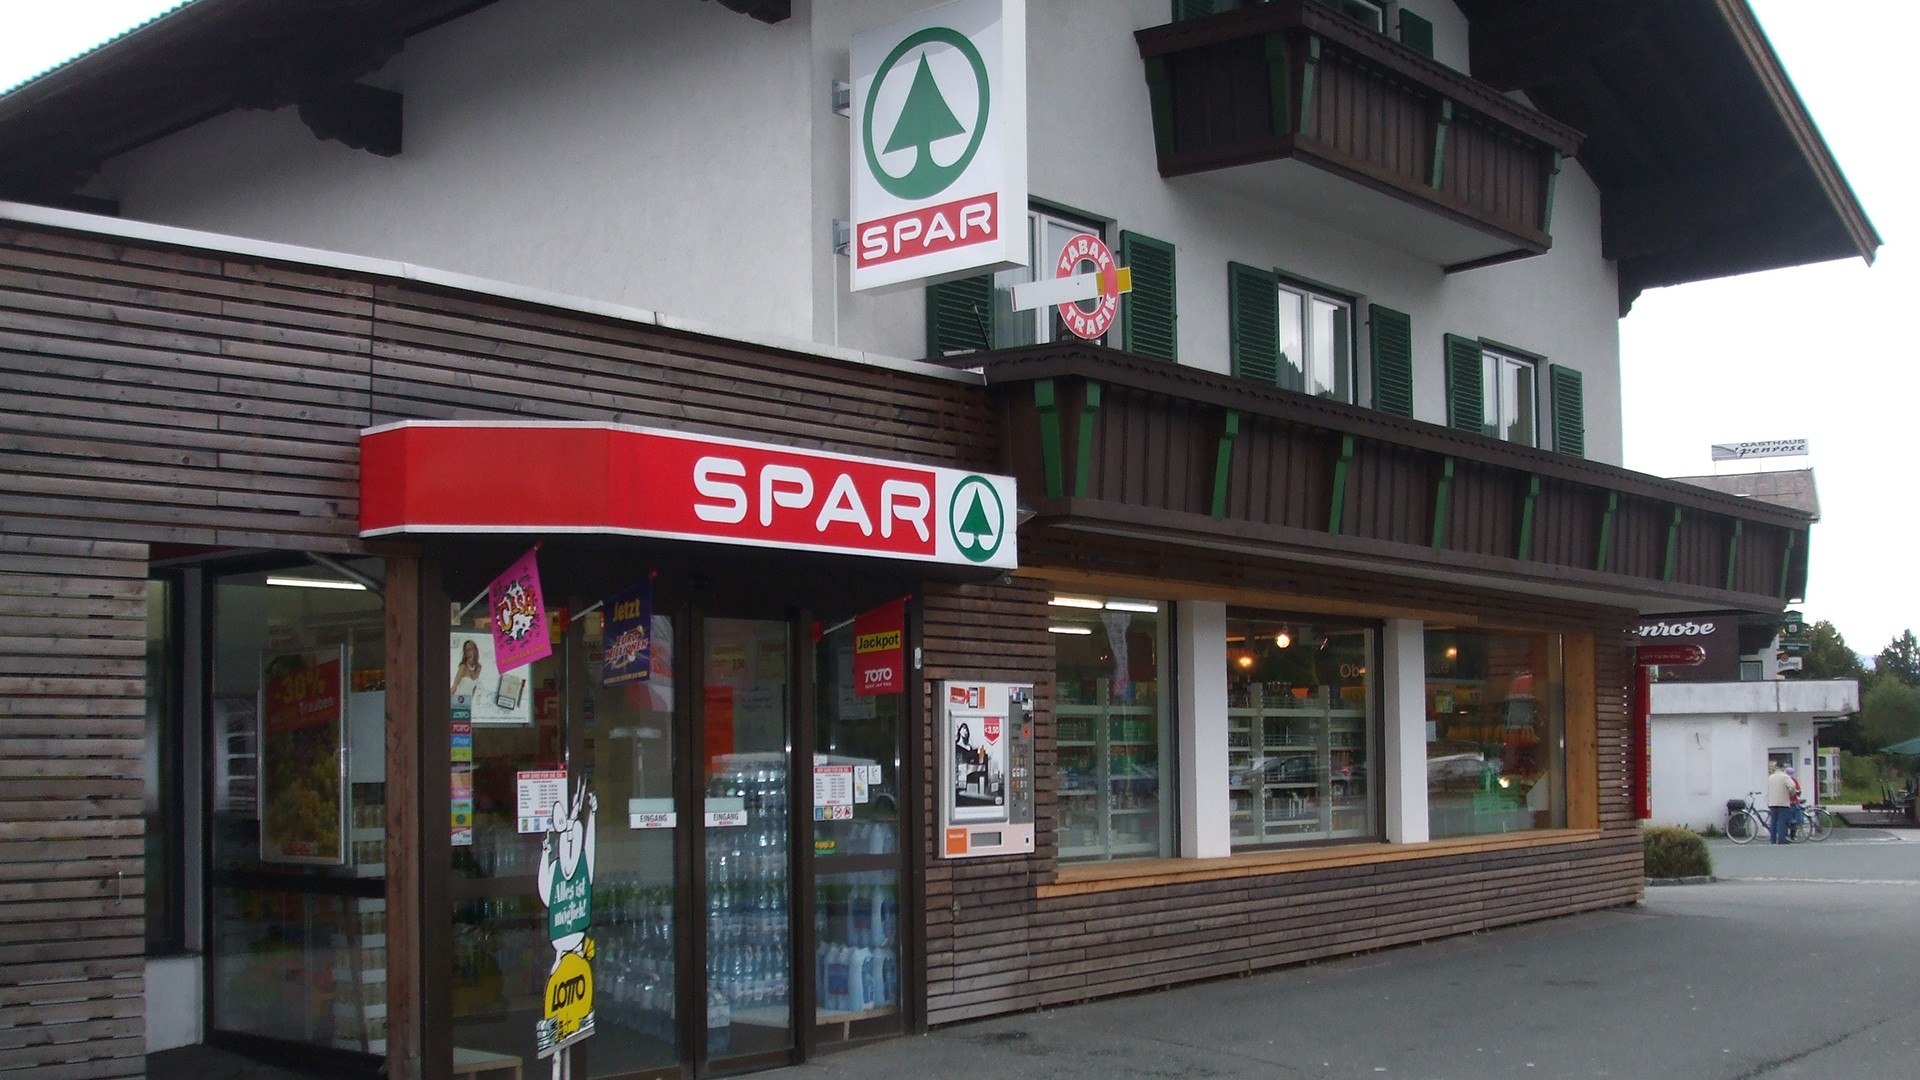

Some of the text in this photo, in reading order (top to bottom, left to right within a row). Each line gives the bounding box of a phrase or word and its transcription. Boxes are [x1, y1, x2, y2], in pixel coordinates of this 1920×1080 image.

[862, 202, 991, 260] SPAR
[1060, 239, 1109, 272] TABAK
[1065, 295, 1116, 335] TRAFIK
[1740, 438, 1806, 448] GASTHAUS
[693, 456, 931, 542] SPAR
[613, 599, 640, 622] Jetzt
[858, 634, 900, 651] Jackpot
[864, 667, 893, 683] TOTO
[640, 814, 667, 823] EINGANG
[713, 813, 738, 821] EINGANG
[553, 876, 587, 904] Alles ist
[554, 899, 587, 932] möglich!
[551, 974, 586, 1014] LOTTO
